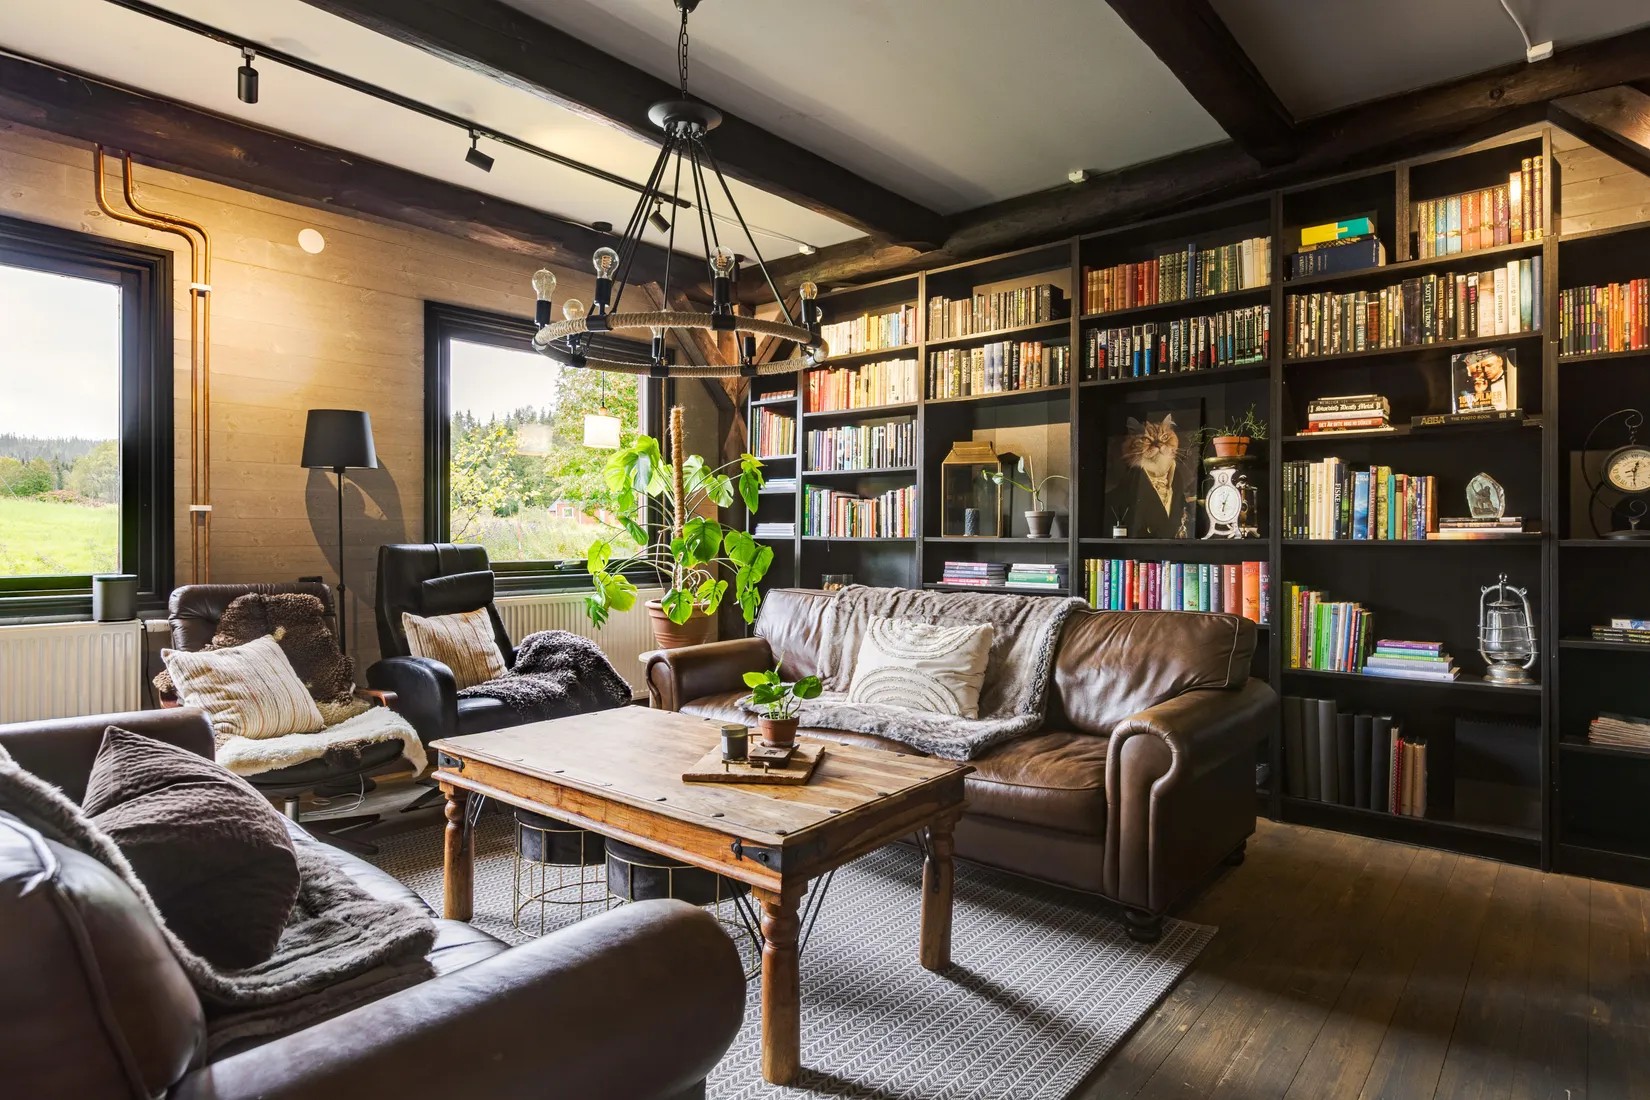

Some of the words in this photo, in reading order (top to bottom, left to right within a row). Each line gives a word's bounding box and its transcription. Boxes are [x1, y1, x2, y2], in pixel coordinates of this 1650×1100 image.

[1339, 403, 1357, 411] Death
[1356, 402, 1375, 410] Metal
[1420, 415, 1446, 426] ABBA
[1334, 482, 1342, 503] FISKE
